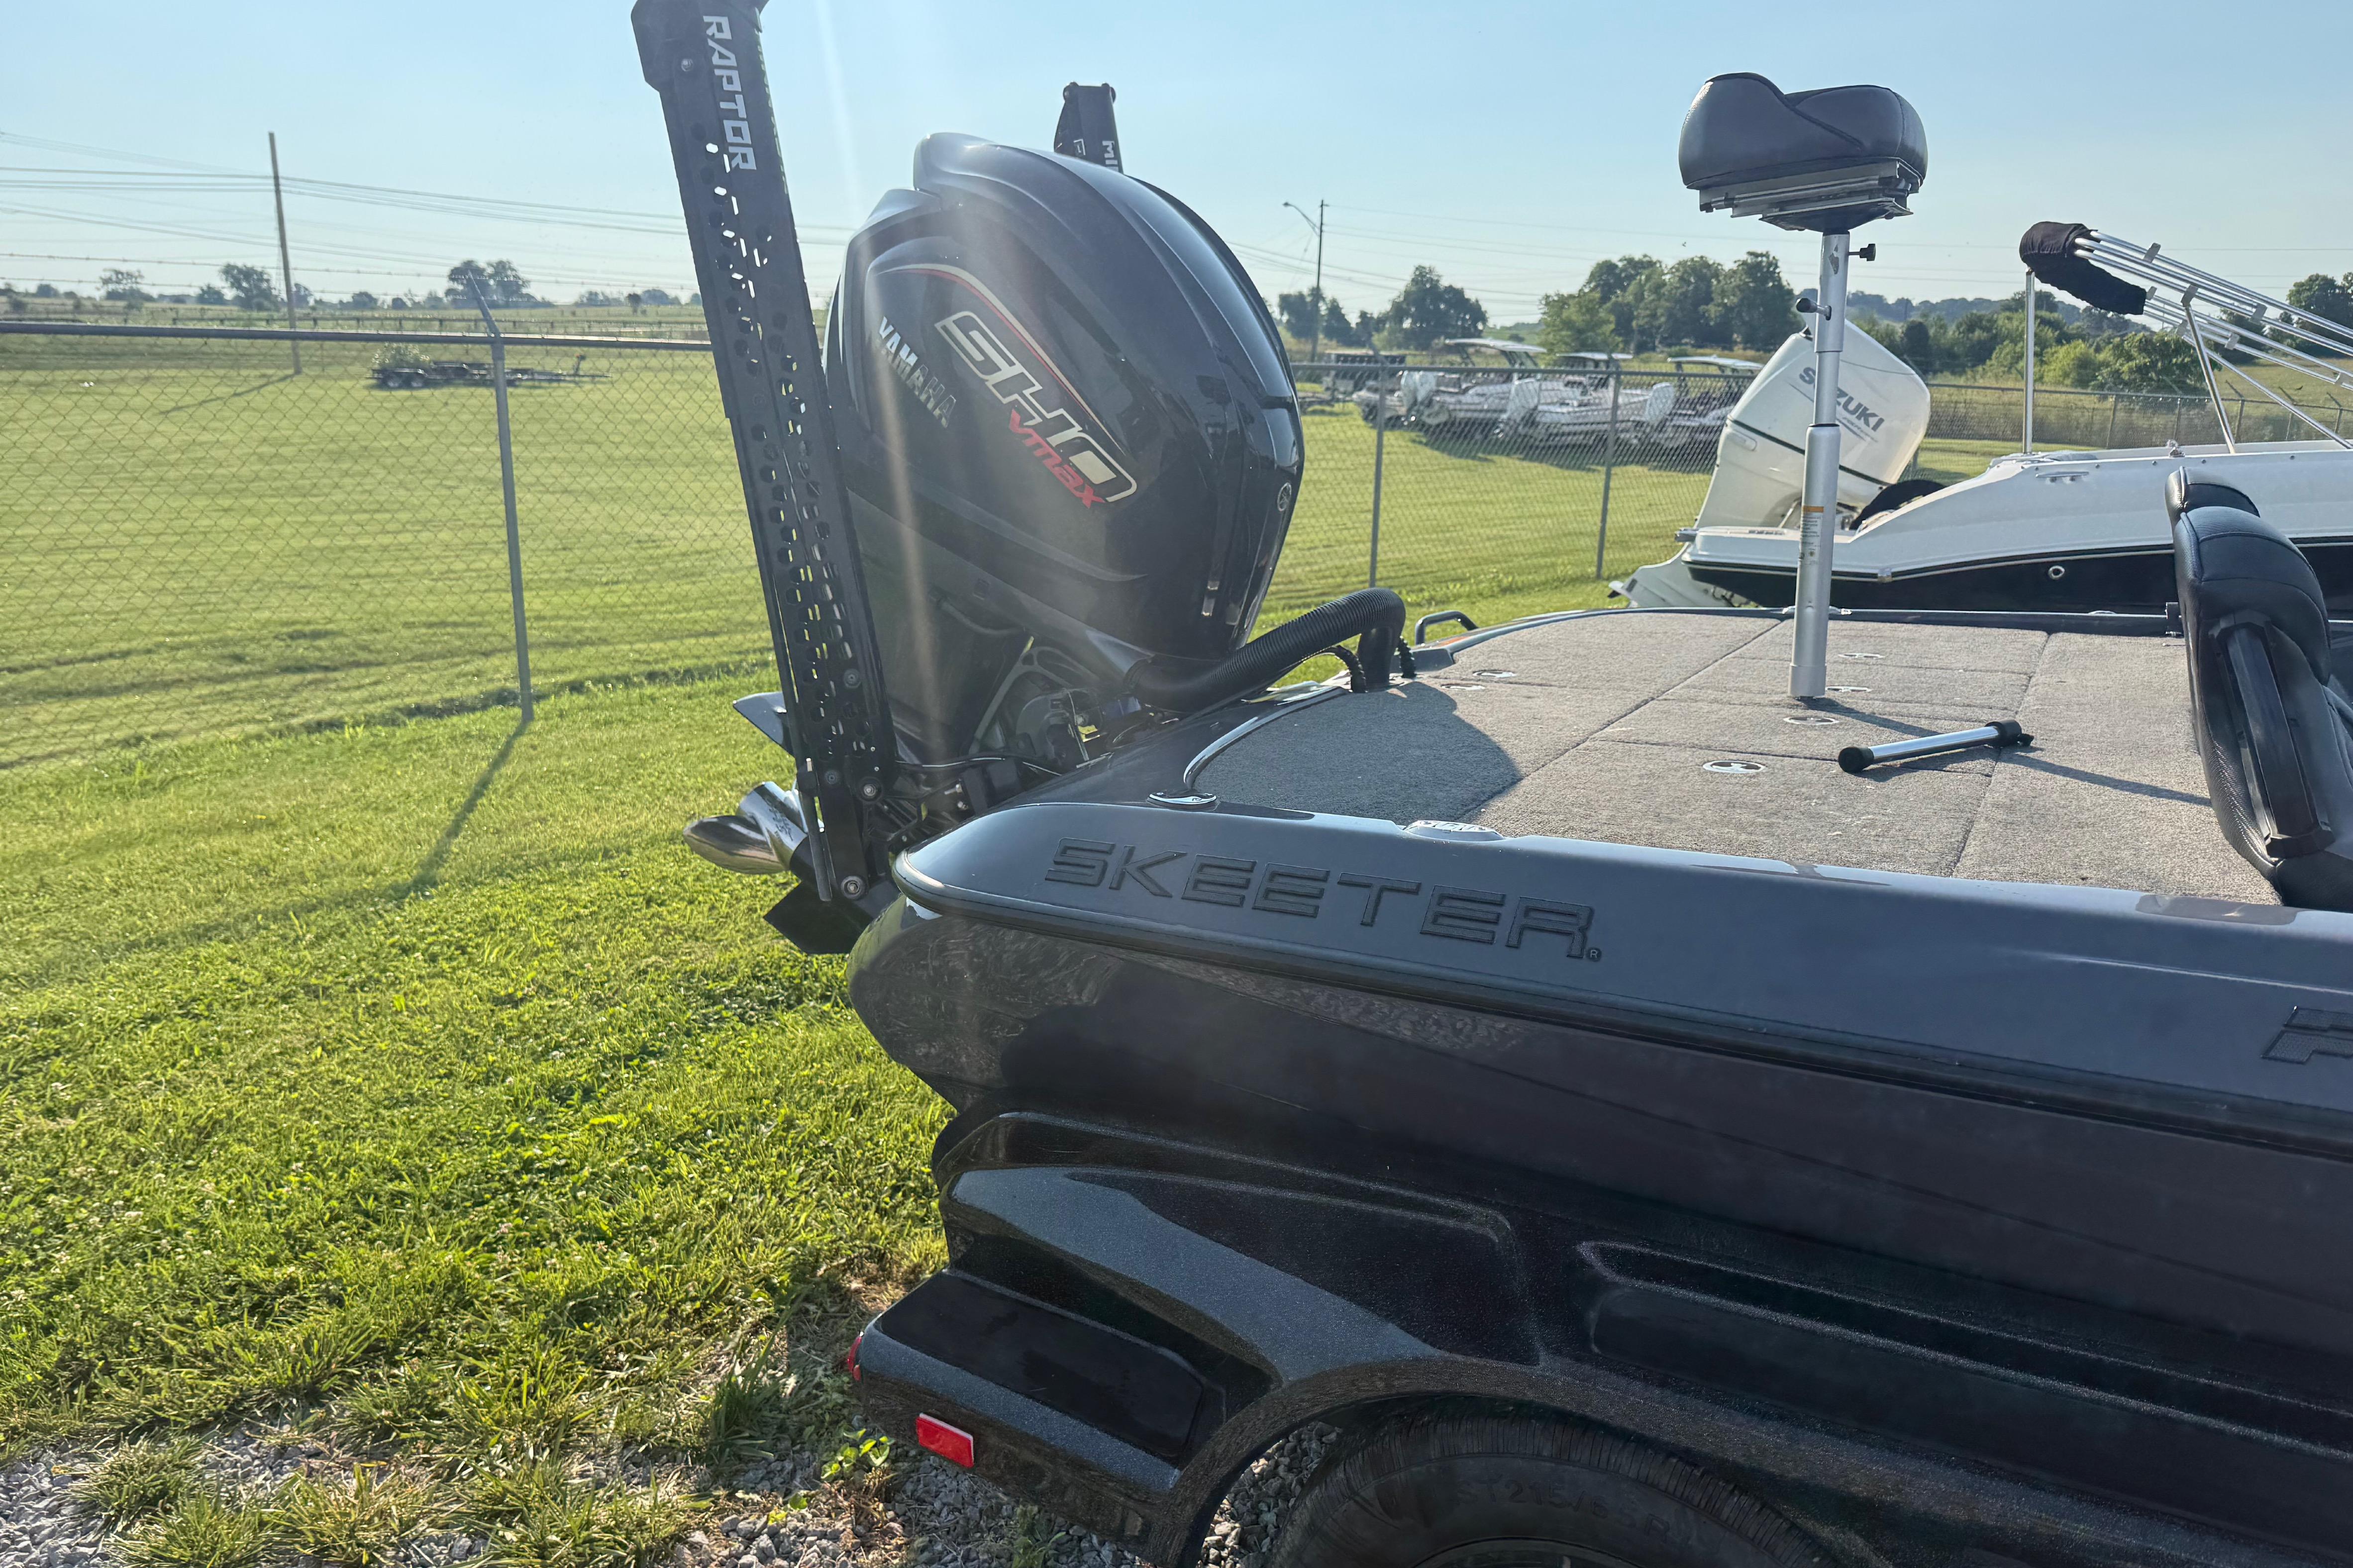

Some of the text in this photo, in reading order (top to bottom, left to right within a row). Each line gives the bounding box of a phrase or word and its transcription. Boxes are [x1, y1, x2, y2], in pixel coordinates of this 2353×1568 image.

[703, 15, 756, 170] RAPTOR
[879, 315, 956, 428] YAMAHA
[934, 310, 1137, 503] SHO
